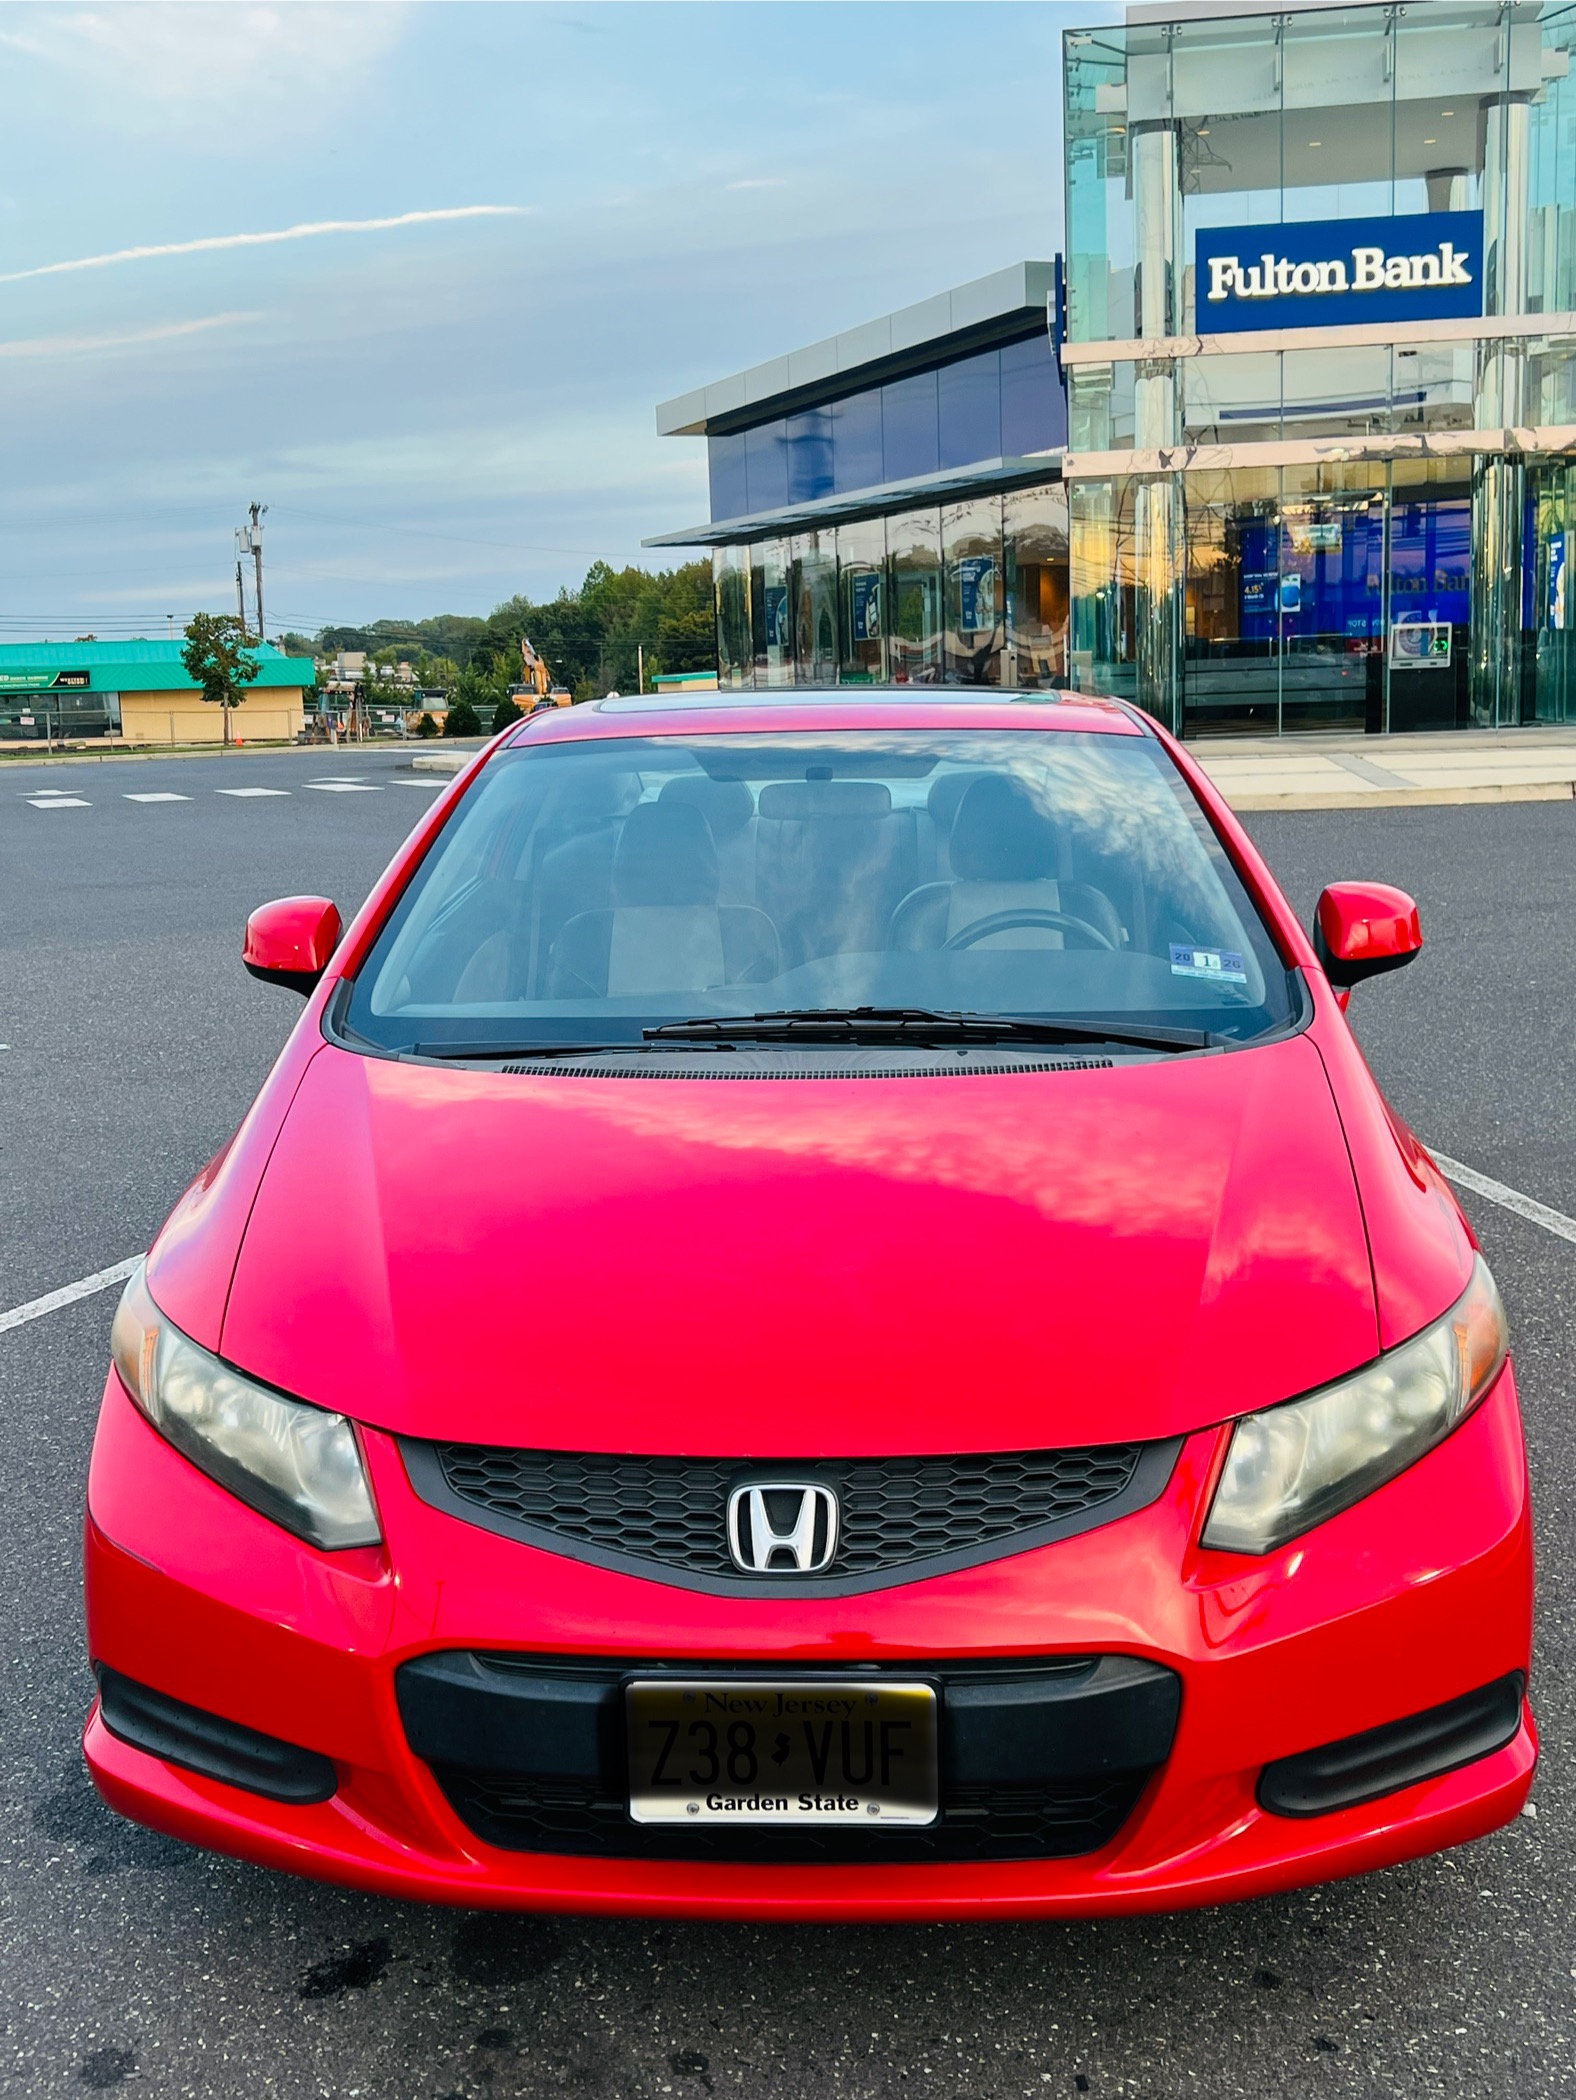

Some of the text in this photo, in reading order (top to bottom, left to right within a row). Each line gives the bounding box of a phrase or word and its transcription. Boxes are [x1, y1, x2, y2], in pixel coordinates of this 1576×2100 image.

[1207, 242, 1473, 301] Fulton Bank
[1175, 952, 1191, 962] 20
[1203, 955, 1211, 967] 1
[704, 1692, 857, 1718] New Jersey
[648, 1720, 912, 1786] Z38 VUF
[706, 1793, 859, 1812] Garden State
